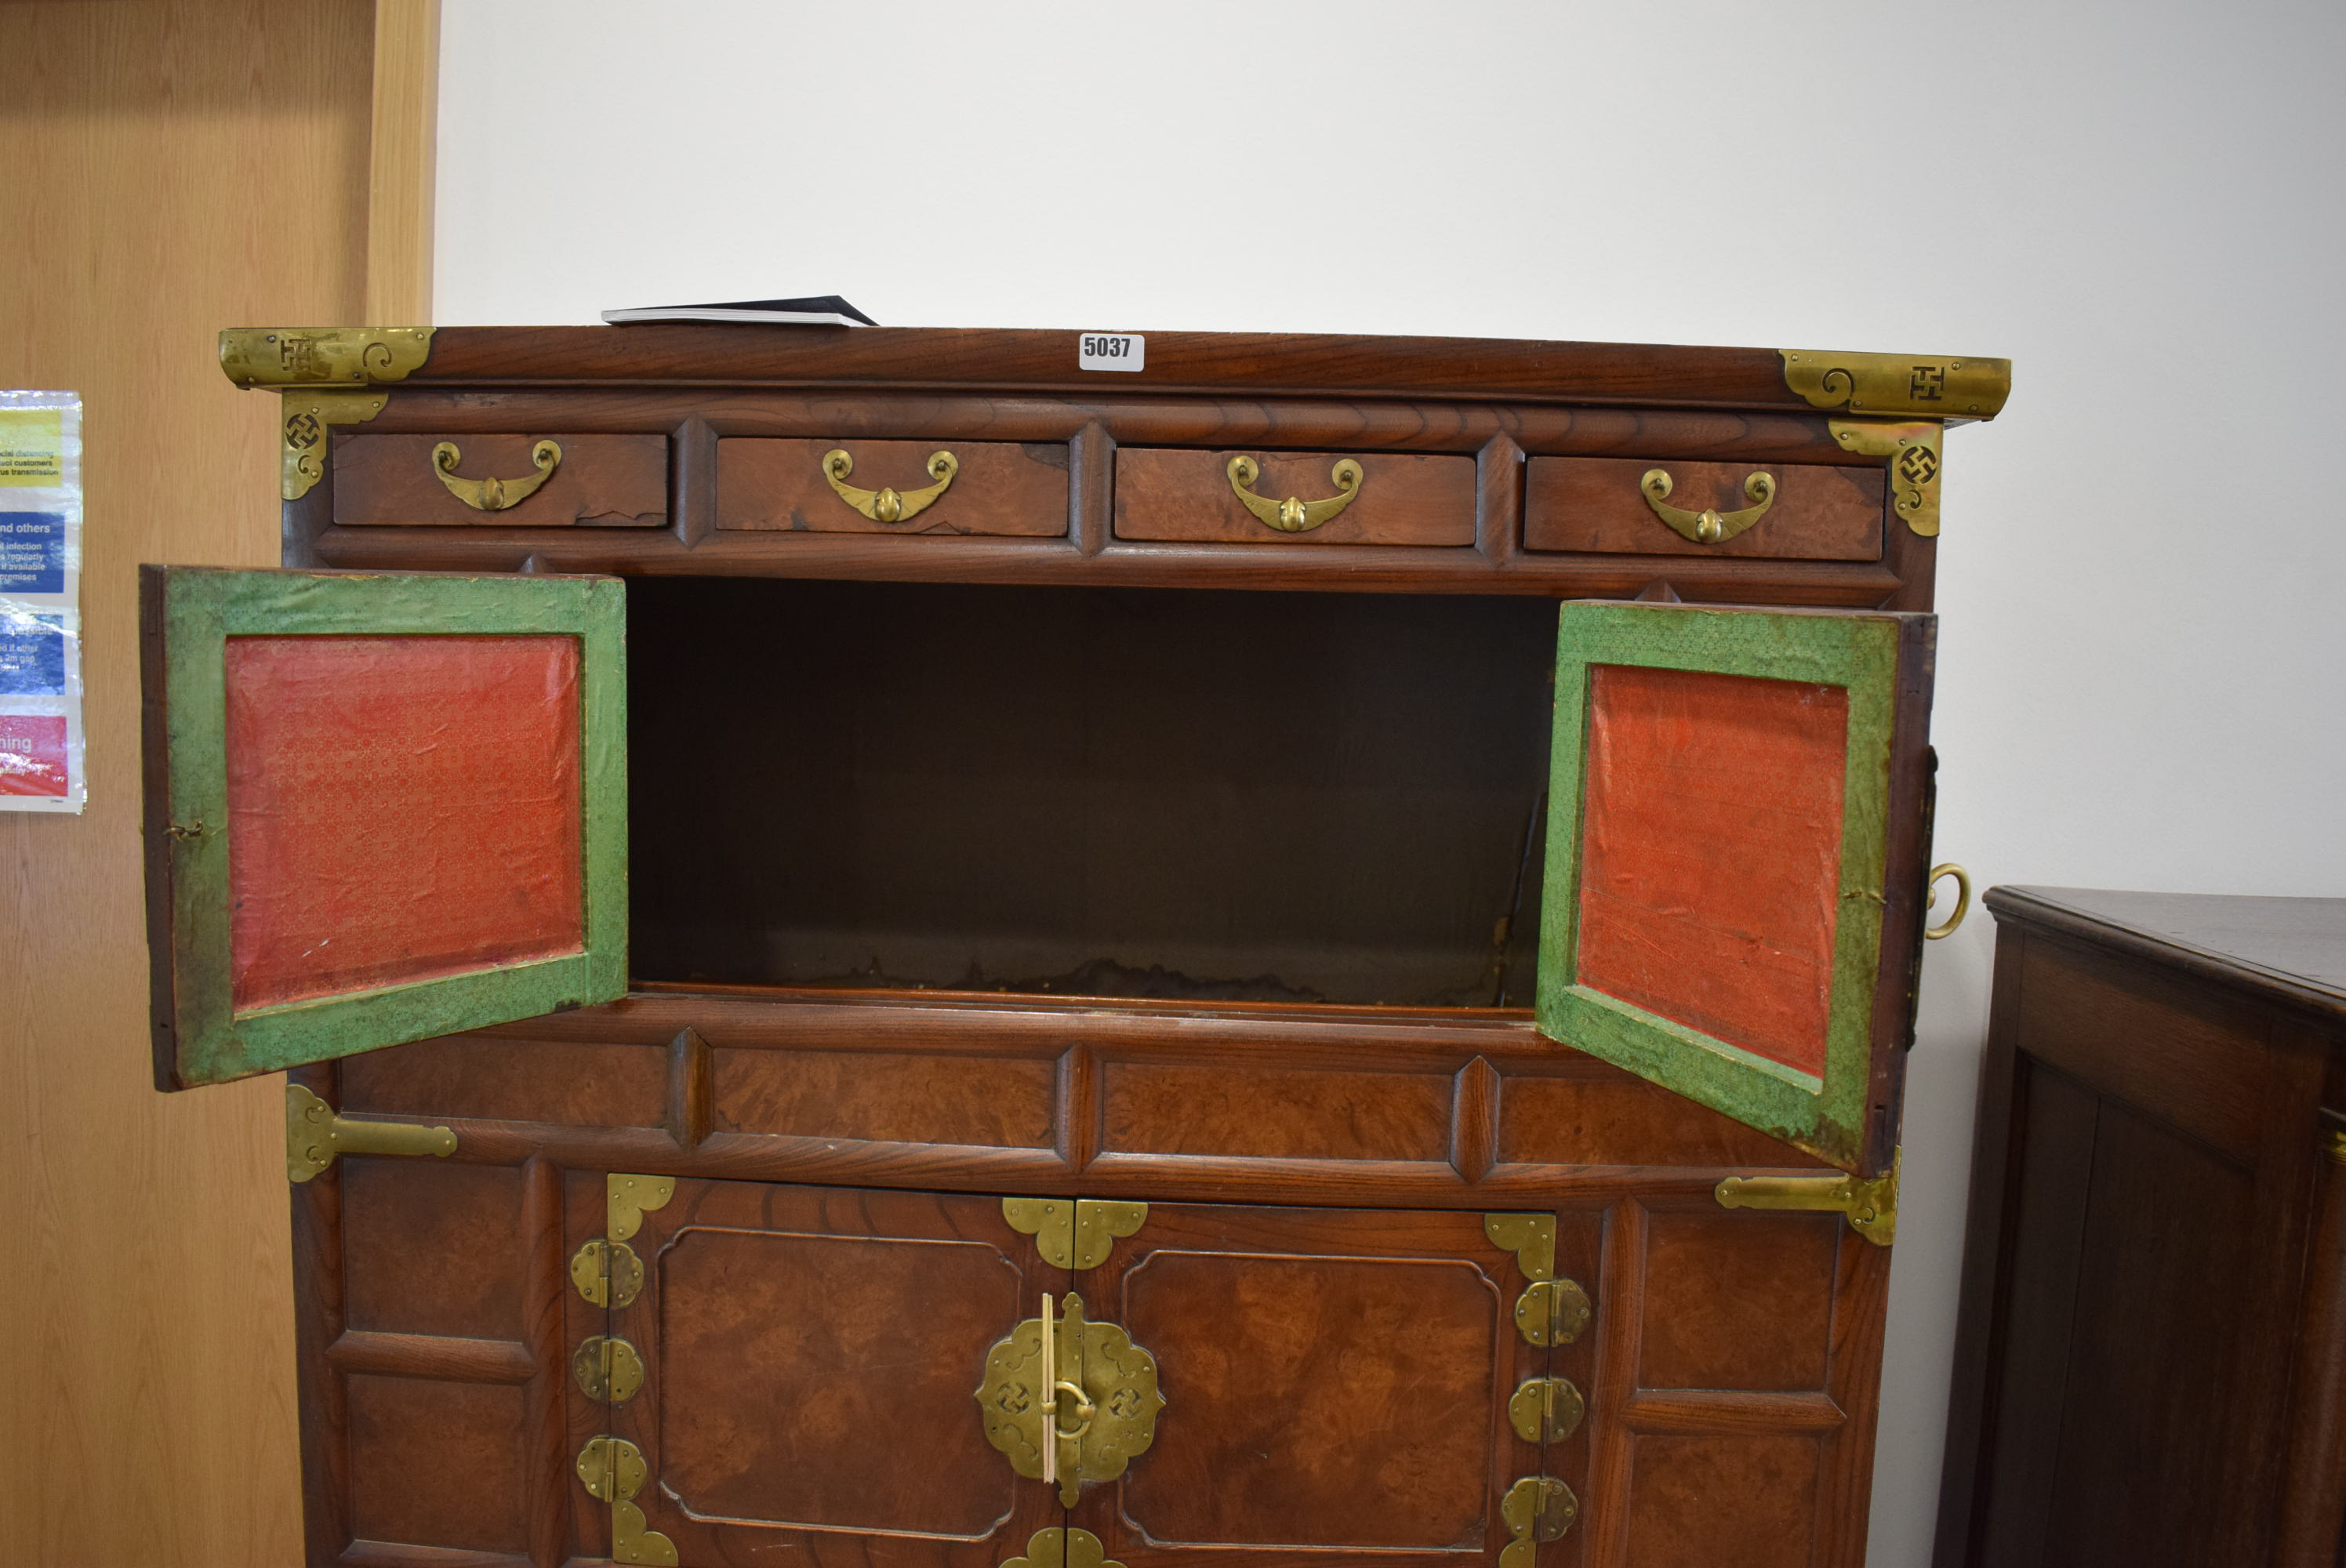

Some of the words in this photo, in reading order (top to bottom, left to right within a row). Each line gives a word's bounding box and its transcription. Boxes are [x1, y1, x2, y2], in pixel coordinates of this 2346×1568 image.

[1084, 337, 1131, 357] 5037
[16, 523, 51, 533] others
[6, 542, 42, 550] infection
[8, 553, 44, 562] regularly
[9, 562, 46, 571] available
[16, 644, 38, 652] other
